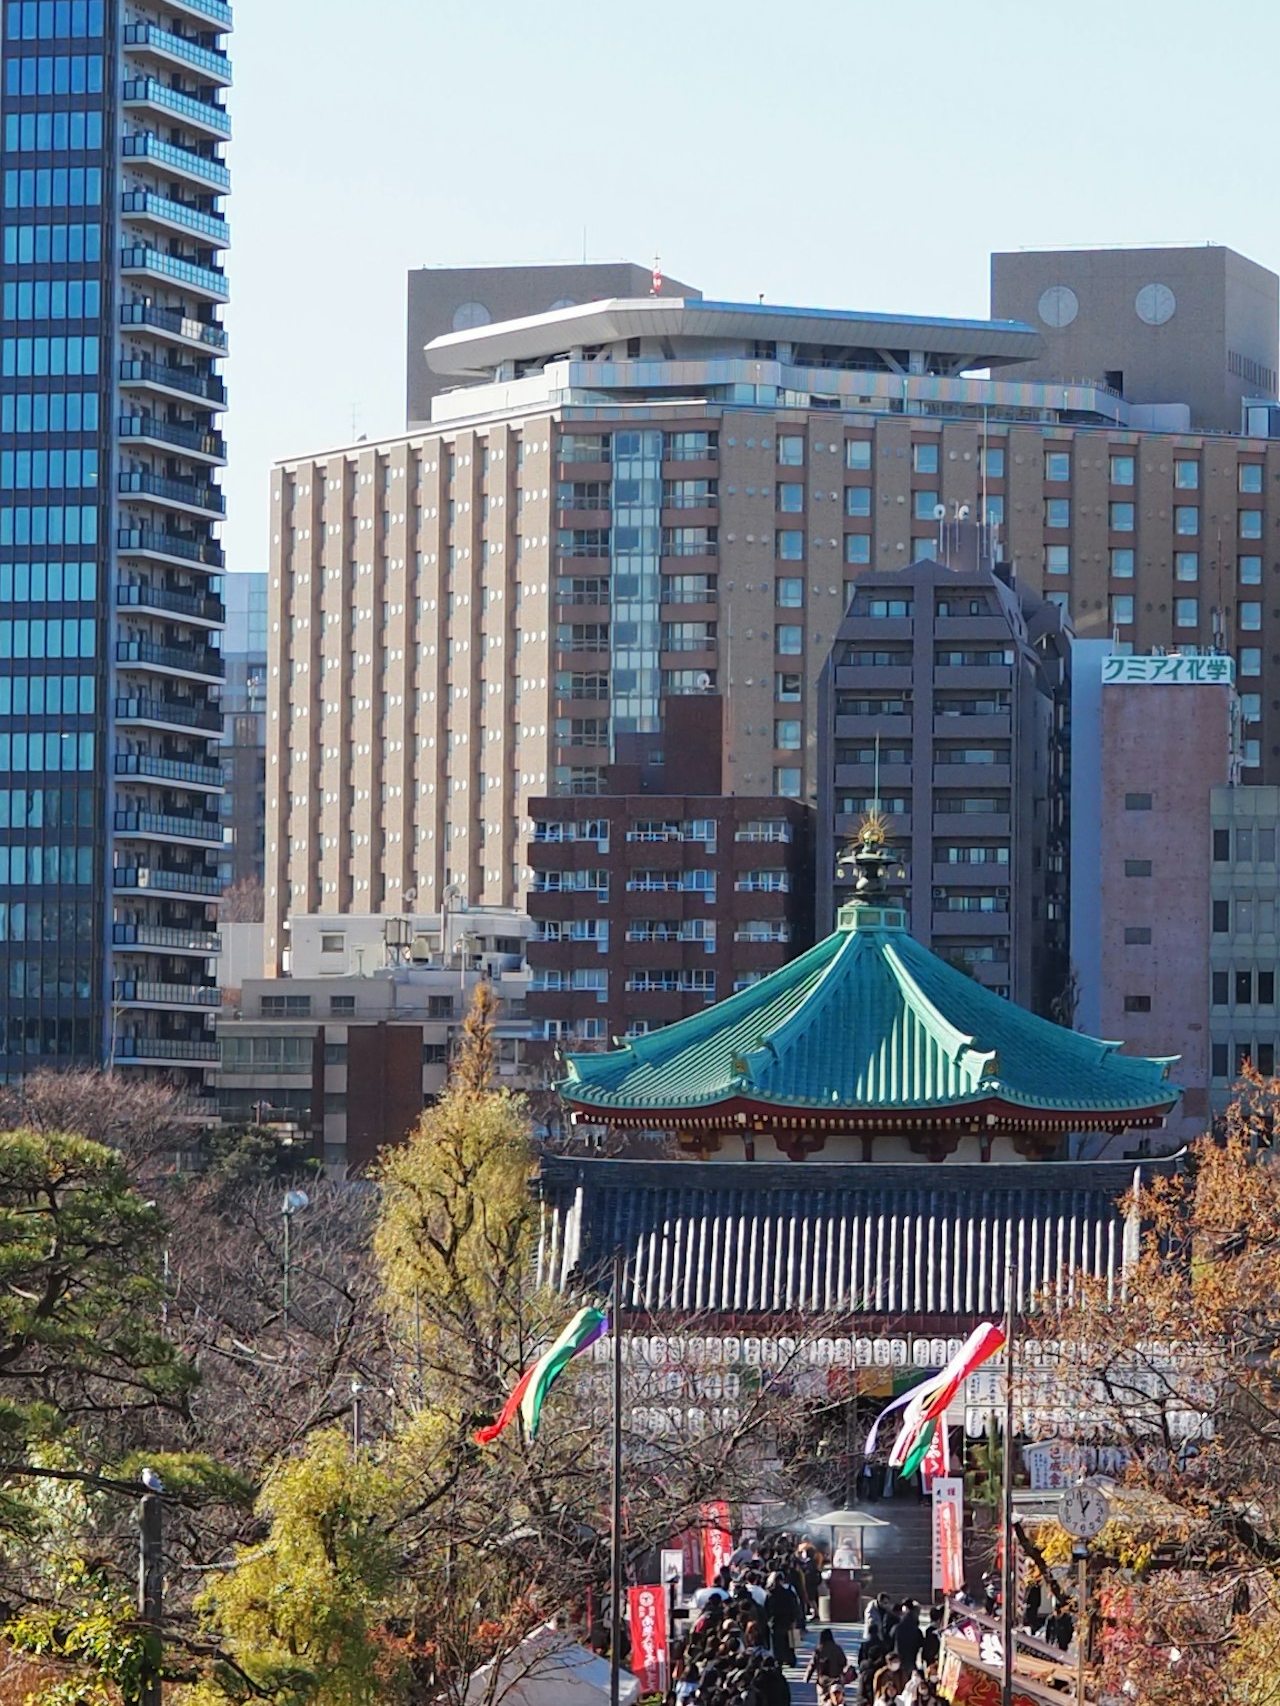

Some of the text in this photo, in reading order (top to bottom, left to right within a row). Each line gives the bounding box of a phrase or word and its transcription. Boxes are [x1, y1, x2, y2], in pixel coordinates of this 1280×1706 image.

[1104, 658, 1228, 681] クミアイ化学
